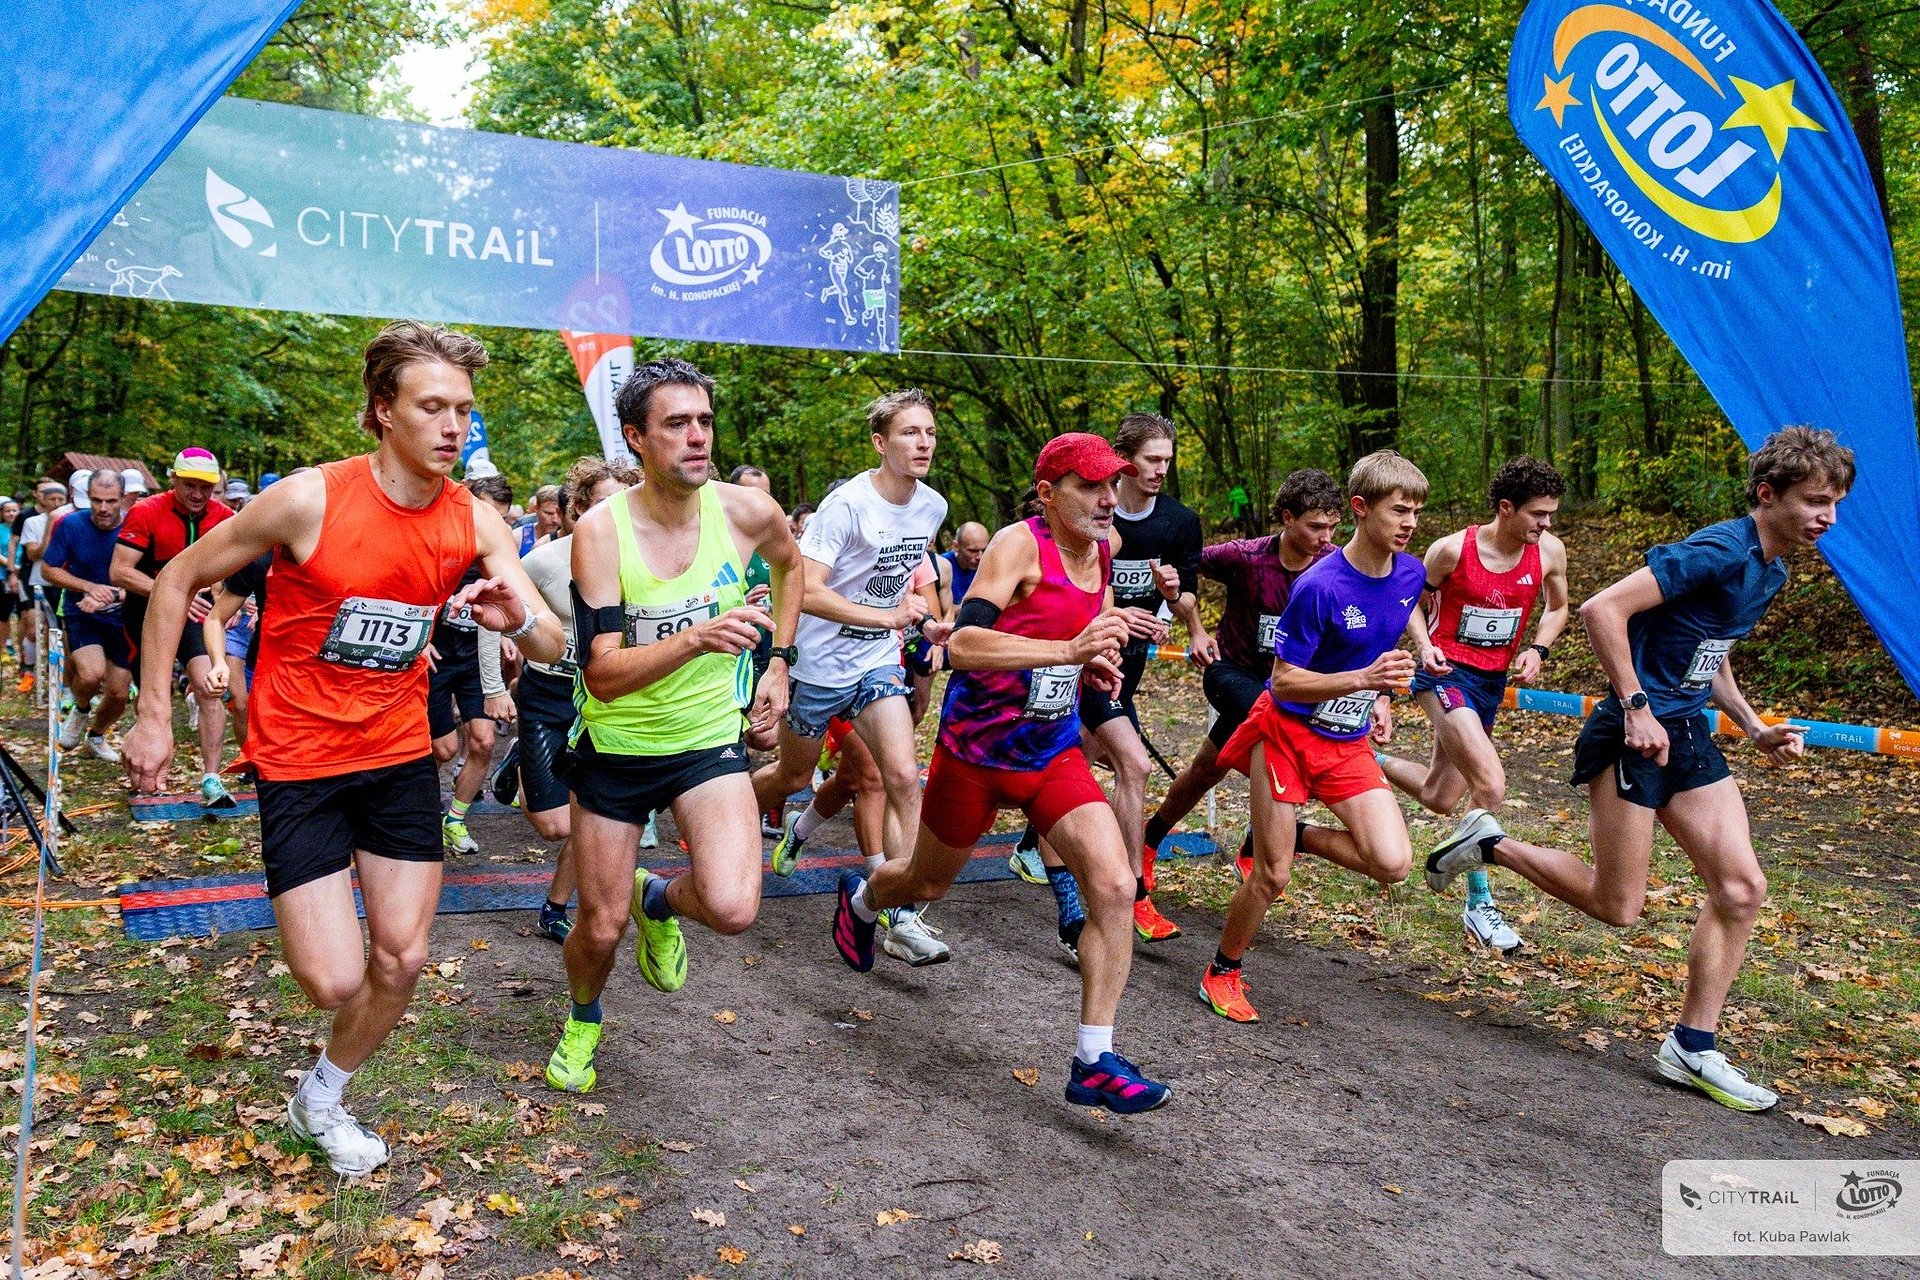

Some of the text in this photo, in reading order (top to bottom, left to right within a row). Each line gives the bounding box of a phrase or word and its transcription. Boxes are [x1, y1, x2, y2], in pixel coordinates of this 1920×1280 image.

[706, 206, 768, 228] FUNDACJA
[674, 235, 749, 272] LOTTO
[650, 280, 741, 301] im. H. KONOPACKIEJ
[358, 619, 411, 647] 1113
[656, 617, 694, 641] 80
[1486, 620, 1498, 632] 6
[1699, 654, 1724, 671] 108
[1328, 699, 1365, 716] 1024
